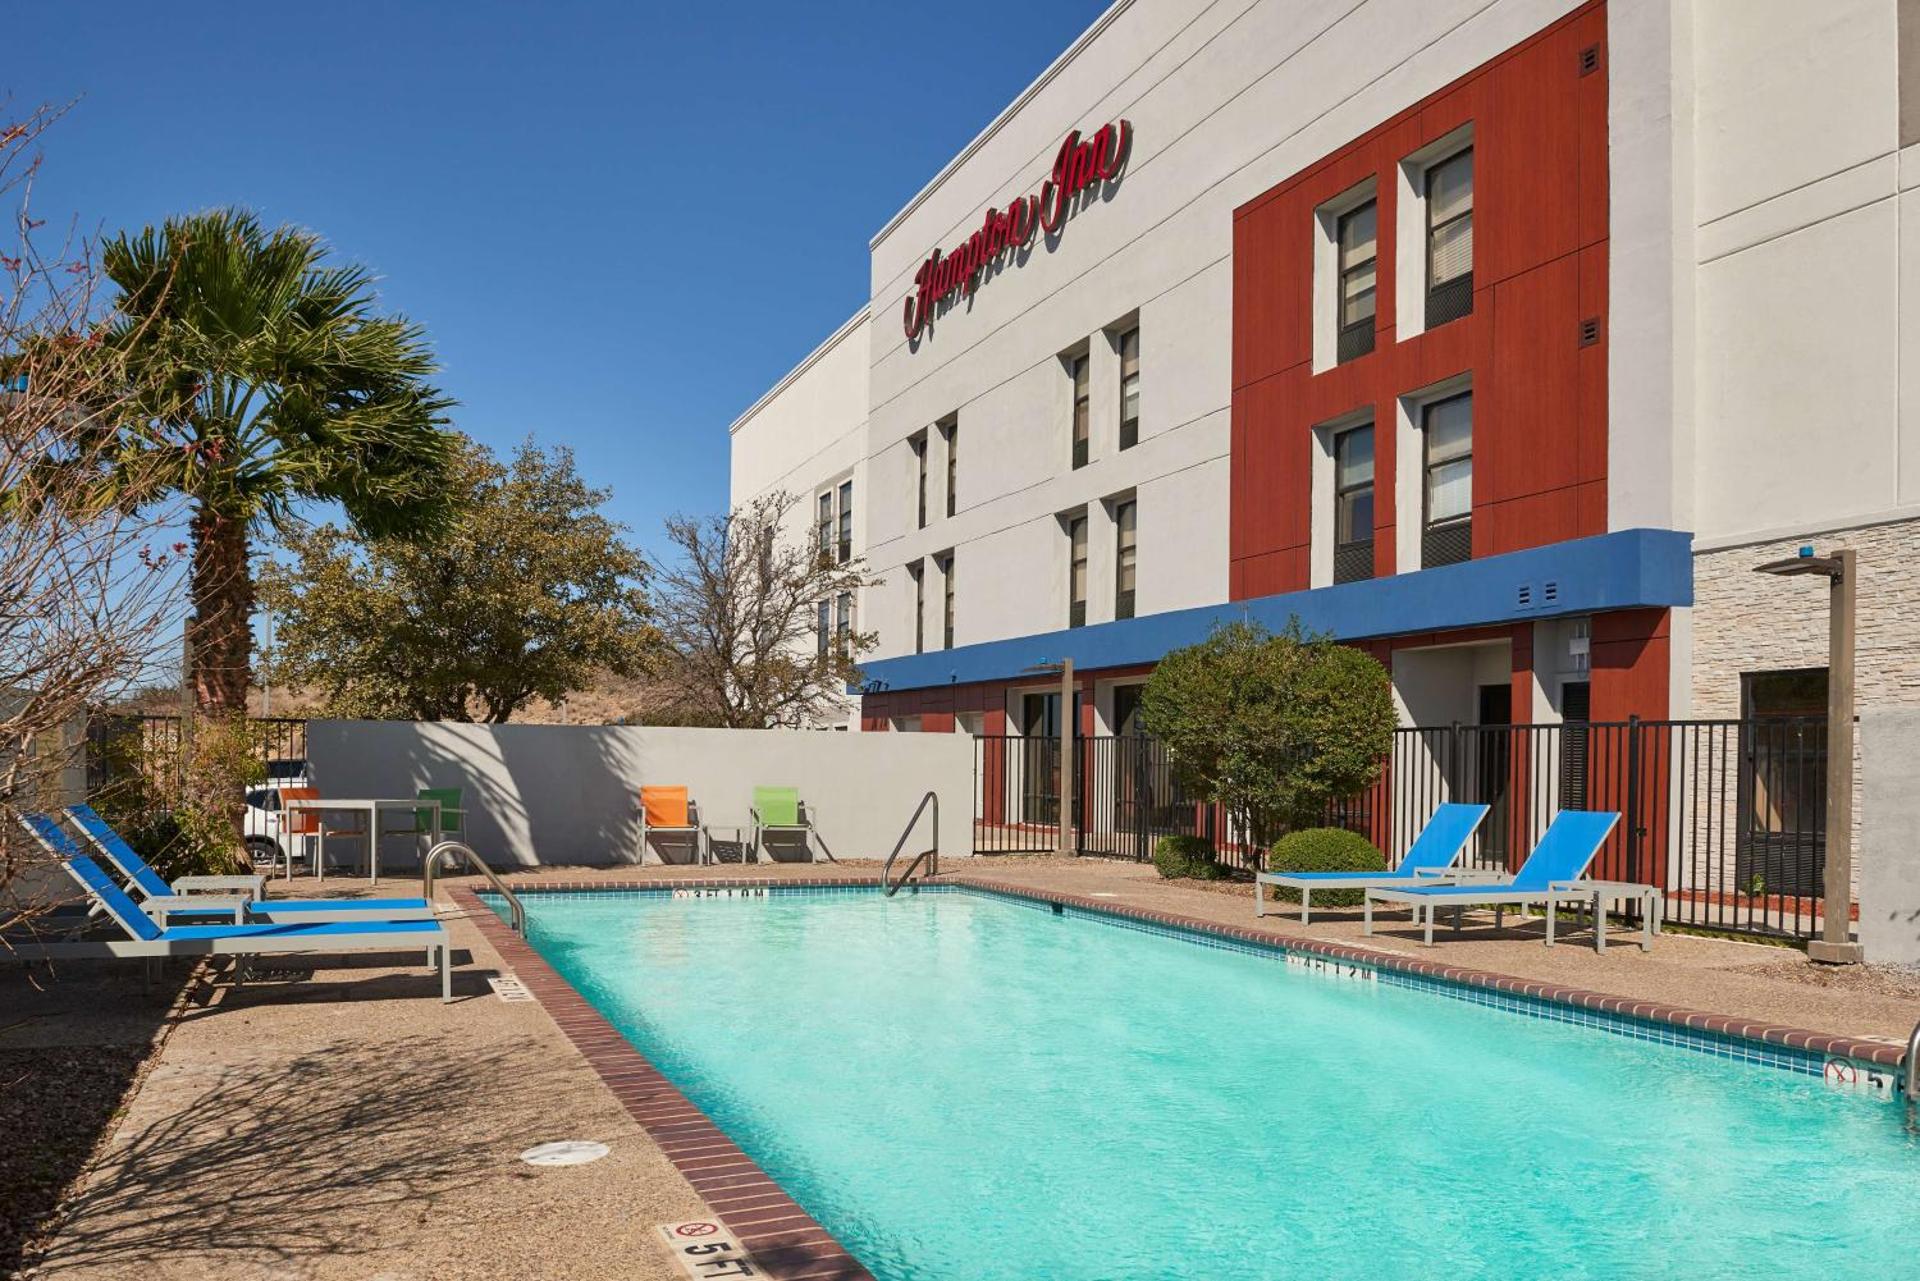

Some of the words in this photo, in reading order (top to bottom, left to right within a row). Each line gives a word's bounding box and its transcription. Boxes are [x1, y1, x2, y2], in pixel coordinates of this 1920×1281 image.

[904, 195, 1039, 339] Hampton
[1040, 119, 1134, 233] Inn
[684, 1242, 732, 1255] 5
[695, 1258, 754, 1278] FT
